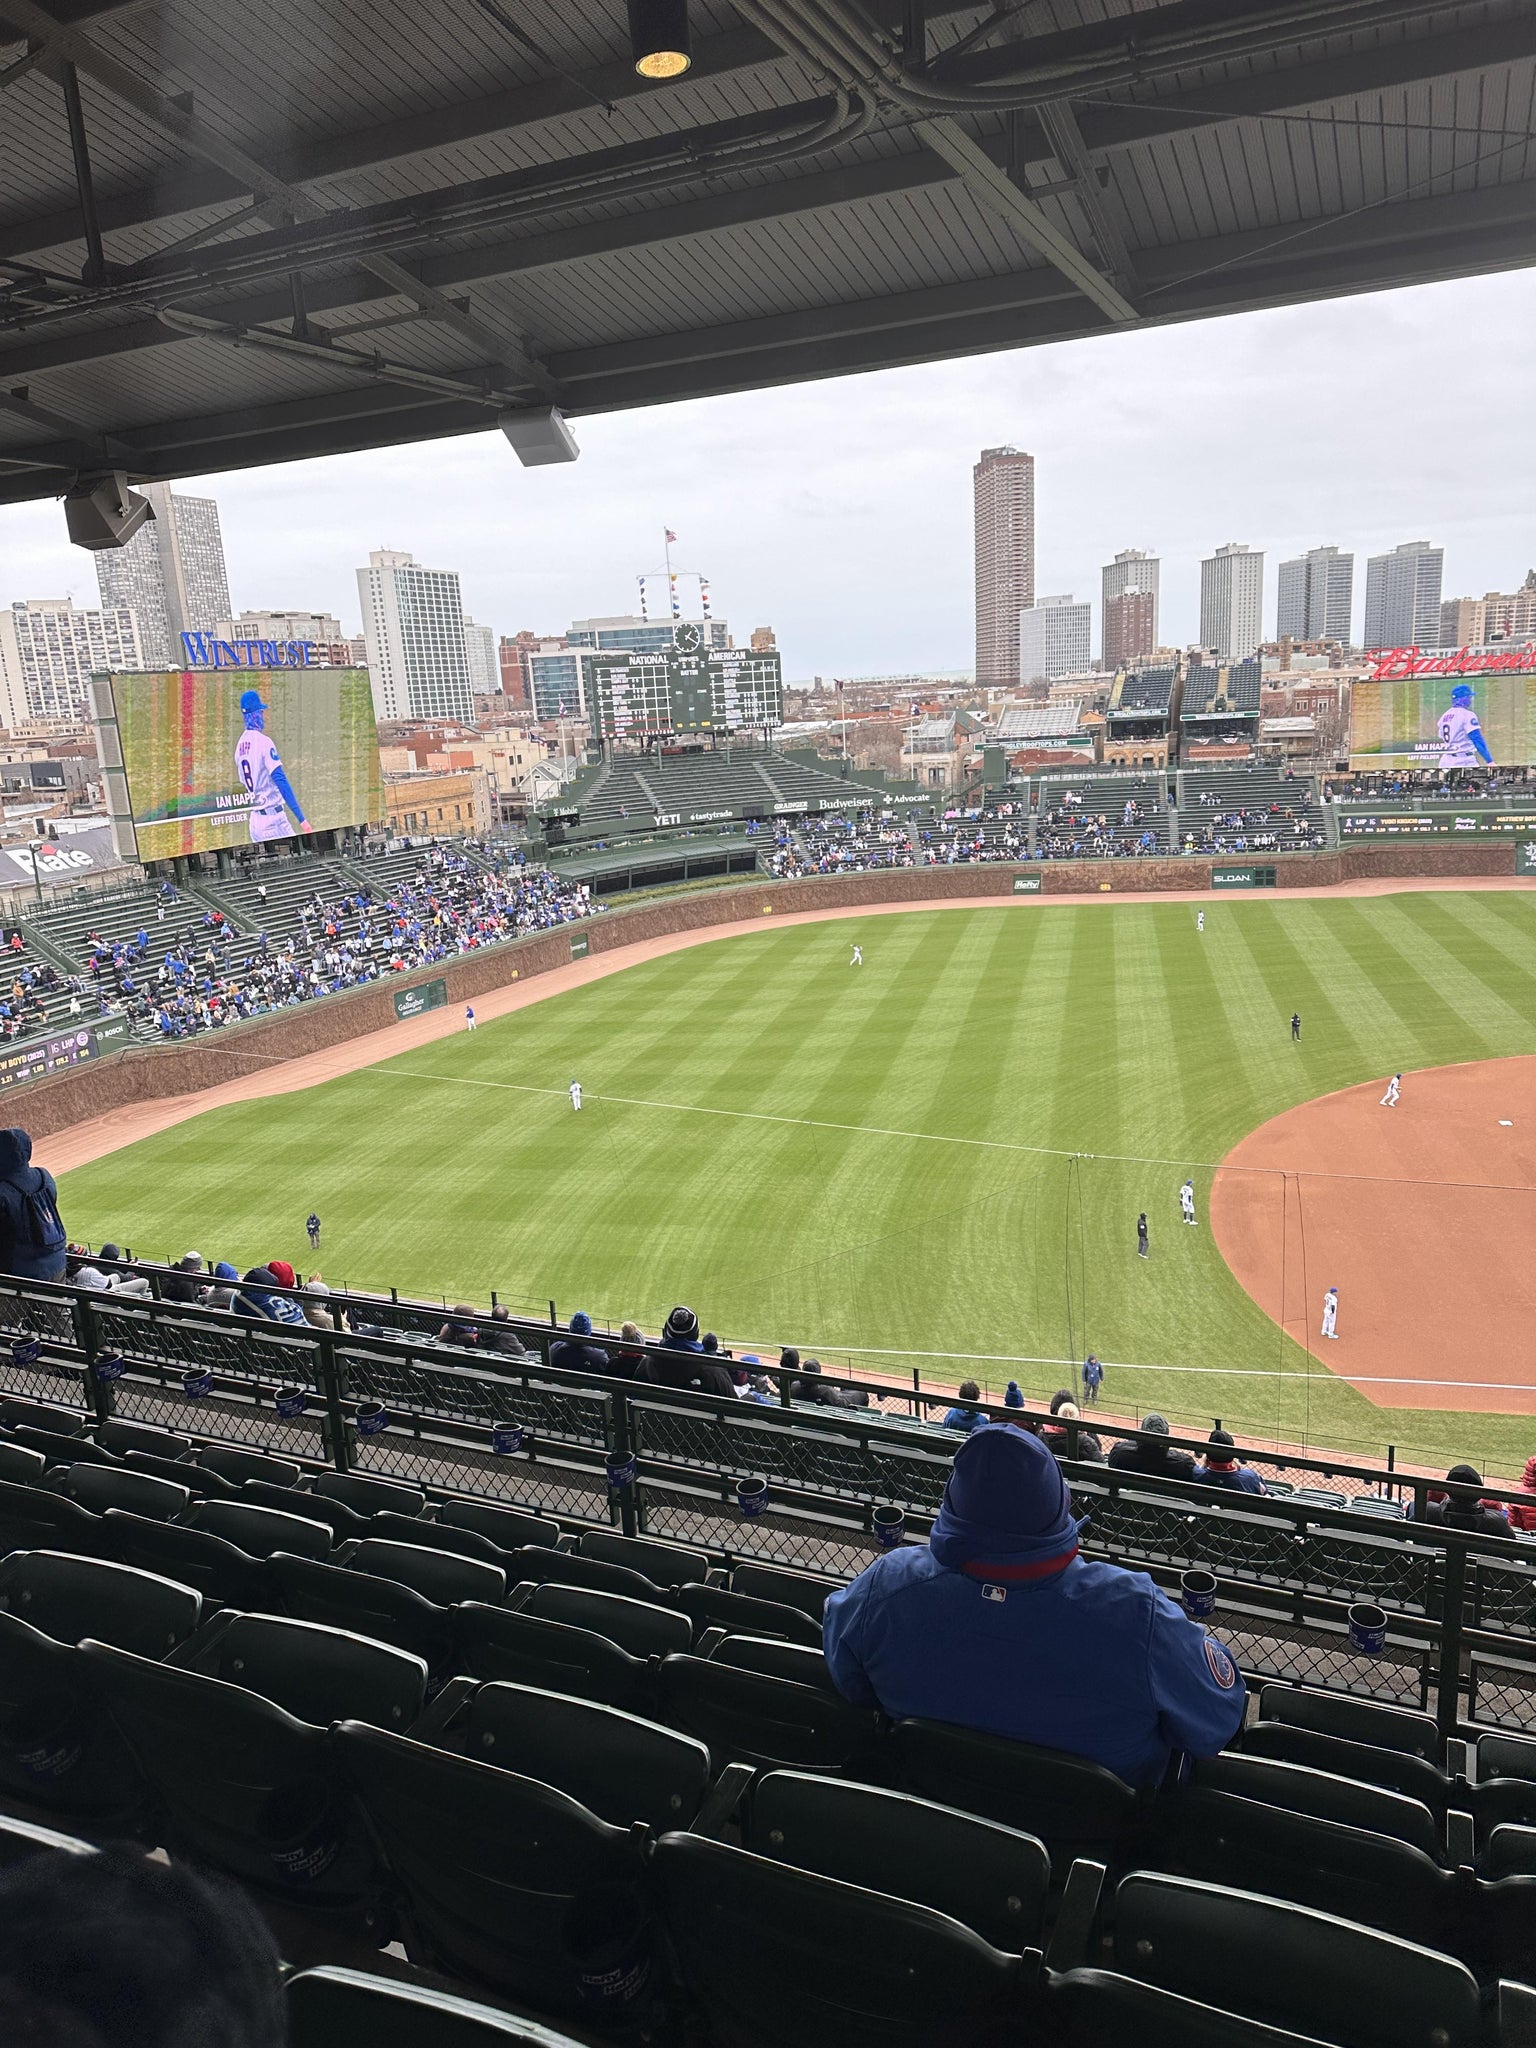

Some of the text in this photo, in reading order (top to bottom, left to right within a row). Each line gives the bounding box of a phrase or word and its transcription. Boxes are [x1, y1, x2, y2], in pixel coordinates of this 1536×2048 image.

[180, 631, 314, 667] WINTRUST
[629, 655, 669, 665] NATIONAL
[708, 651, 746, 661] AMERICAN
[1443, 724, 1451, 743] 8
[241, 760, 254, 792] 8
[216, 792, 256, 808] IAN HAPP
[819, 798, 874, 810] Budweiser
[894, 794, 930, 803] Advocate
[774, 801, 808, 810] GRAINGER
[211, 813, 248, 826] LEFT FIELDER
[654, 814, 681, 826] YETI
[695, 810, 733, 821] tastytrade
[5, 849, 94, 875] Rate
[1015, 880, 1040, 889] Hefty
[104, 1026, 123, 1037] BOSCH
[51, 1038, 75, 1054] 16 LHP
[8, 1054, 27, 1068] BOYD
[582, 1969, 620, 1984] Hefty
